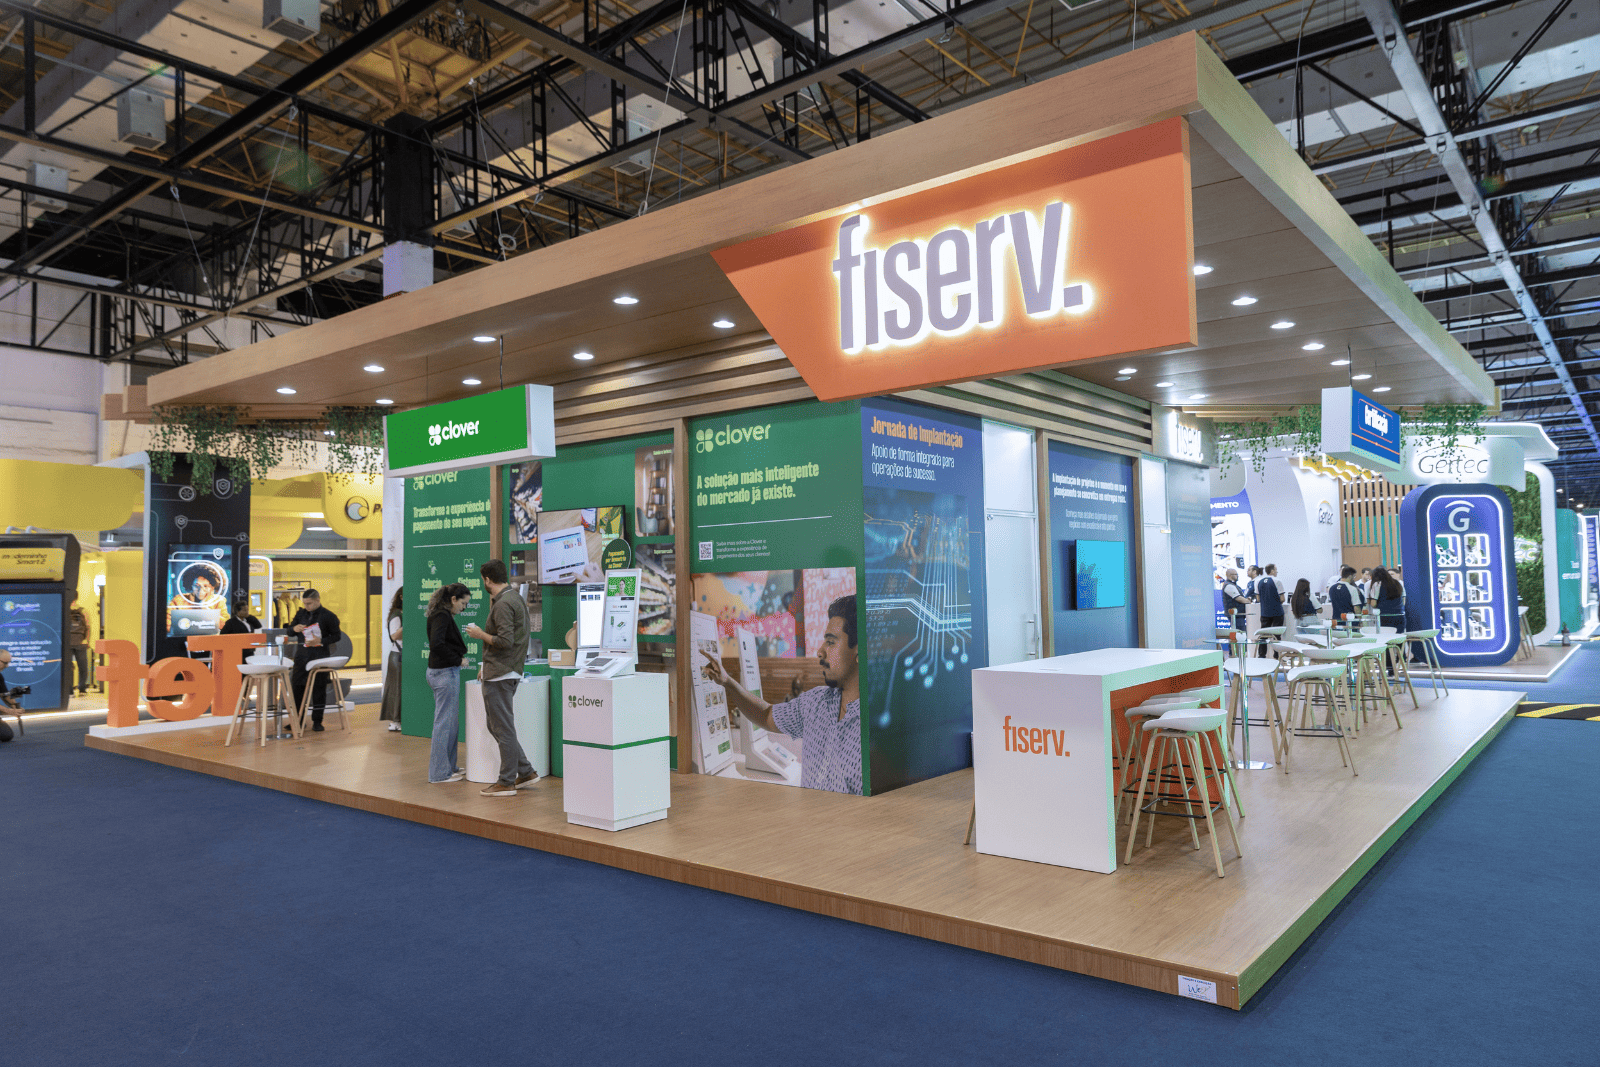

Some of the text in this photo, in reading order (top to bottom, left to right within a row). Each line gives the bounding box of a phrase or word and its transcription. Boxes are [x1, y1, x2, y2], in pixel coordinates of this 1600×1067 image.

[832, 201, 1083, 350] fiserv.
[441, 420, 479, 440] clover
[715, 424, 771, 446] clover
[871, 416, 963, 451] Jornada de Implantação
[871, 443, 955, 469] Apoio de forma integrada para
[1418, 455, 1489, 474] Gertec
[697, 462, 819, 490] A solução mais inteligente
[871, 462, 937, 481] operações de sucesso.
[697, 483, 796, 506] do mercado já existe.
[413, 505, 446, 518] Transforme
[446, 505, 450, 516] a
[450, 500, 485, 517] experiência
[412, 518, 443, 534] pagamento
[452, 518, 462, 528] seu
[577, 695, 604, 708] clover
[1003, 716, 1070, 757] fiserv.
